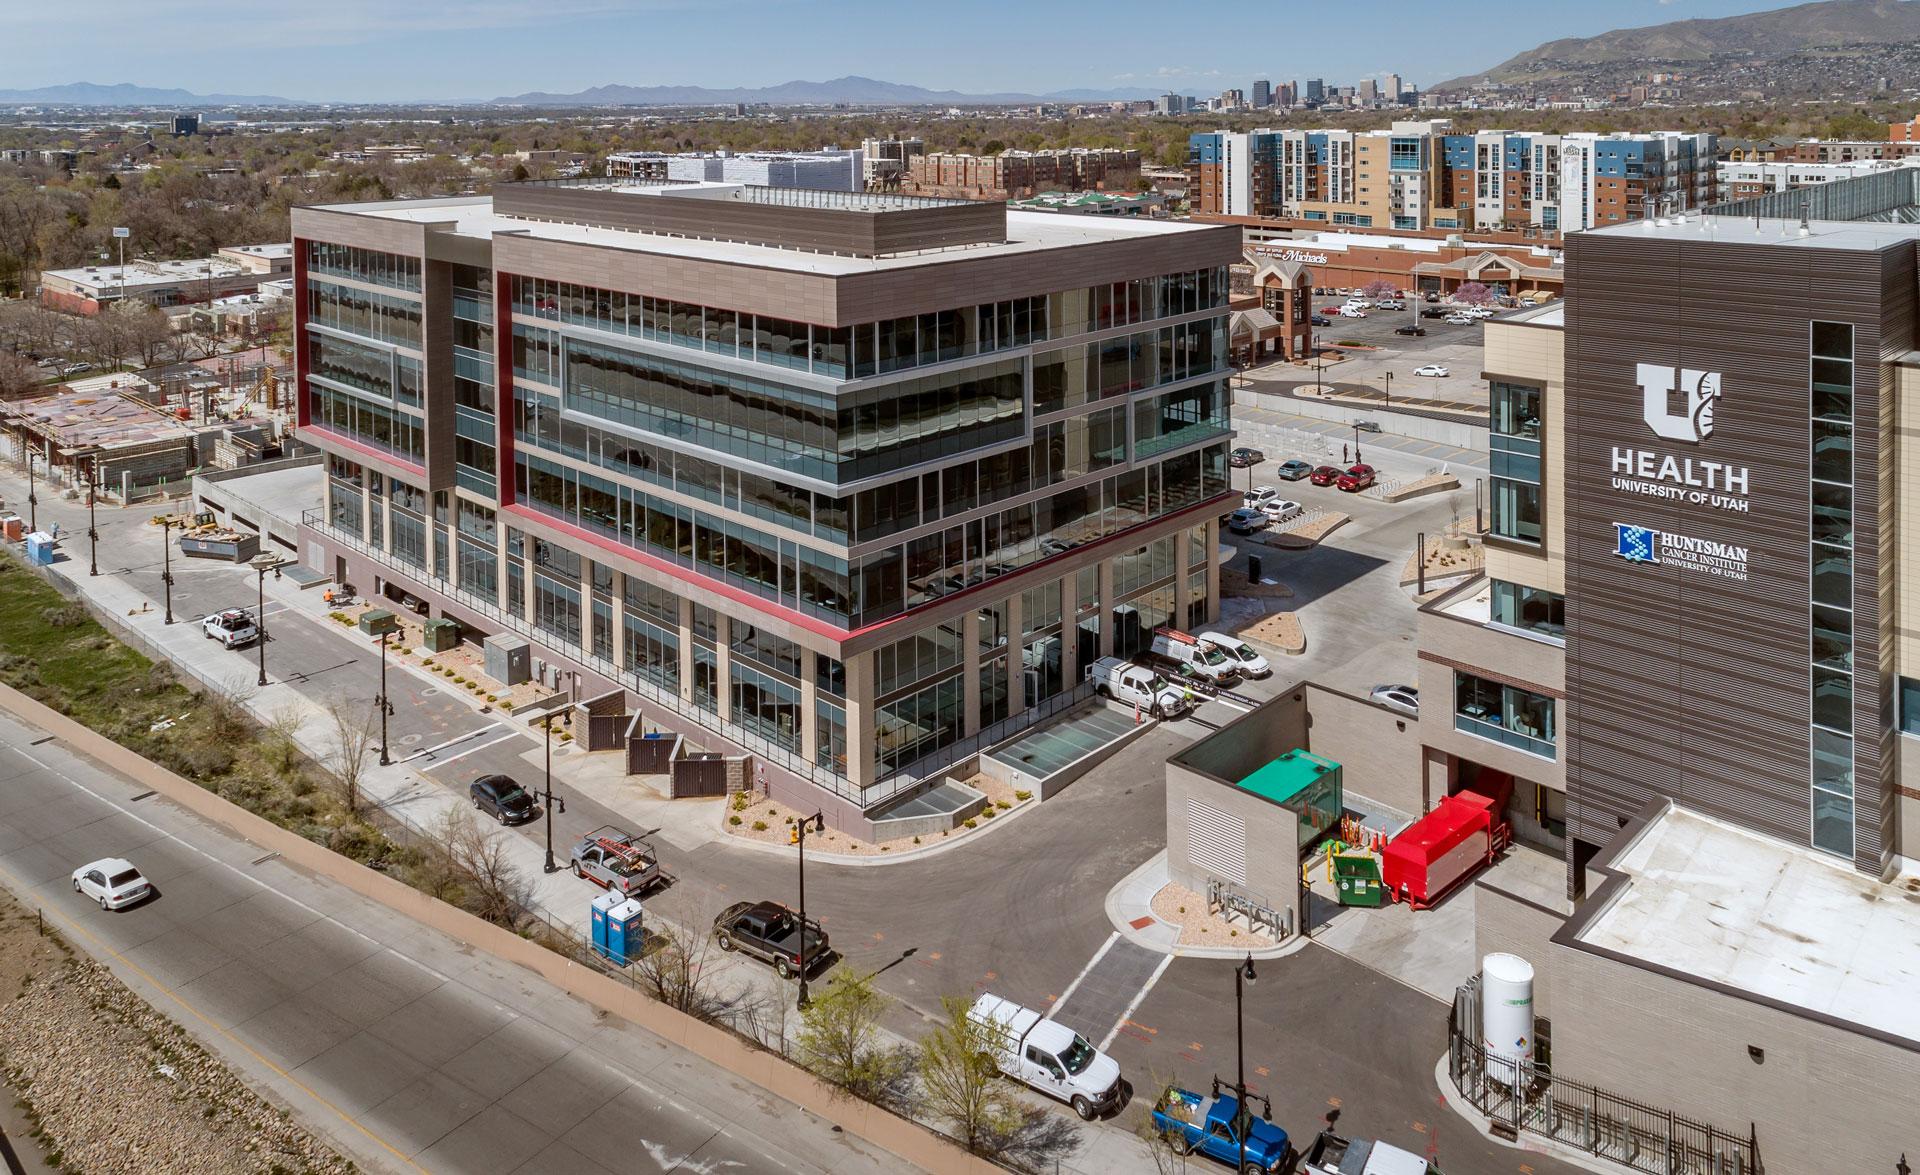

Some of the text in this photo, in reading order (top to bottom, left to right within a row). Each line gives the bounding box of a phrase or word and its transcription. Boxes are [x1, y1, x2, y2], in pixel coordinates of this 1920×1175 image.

[1282, 249, 1327, 264] Michaels
[1636, 363, 1722, 443] U
[1612, 447, 1749, 495] HEALTH
[1612, 477, 1749, 513] UNIVERSITY OF UTAH
[1661, 532, 1748, 562] HUNTSMAN
[1661, 546, 1748, 572] CANCER INSTITUTE
[1662, 557, 1748, 581] UNIVERSITY OF UTAH
